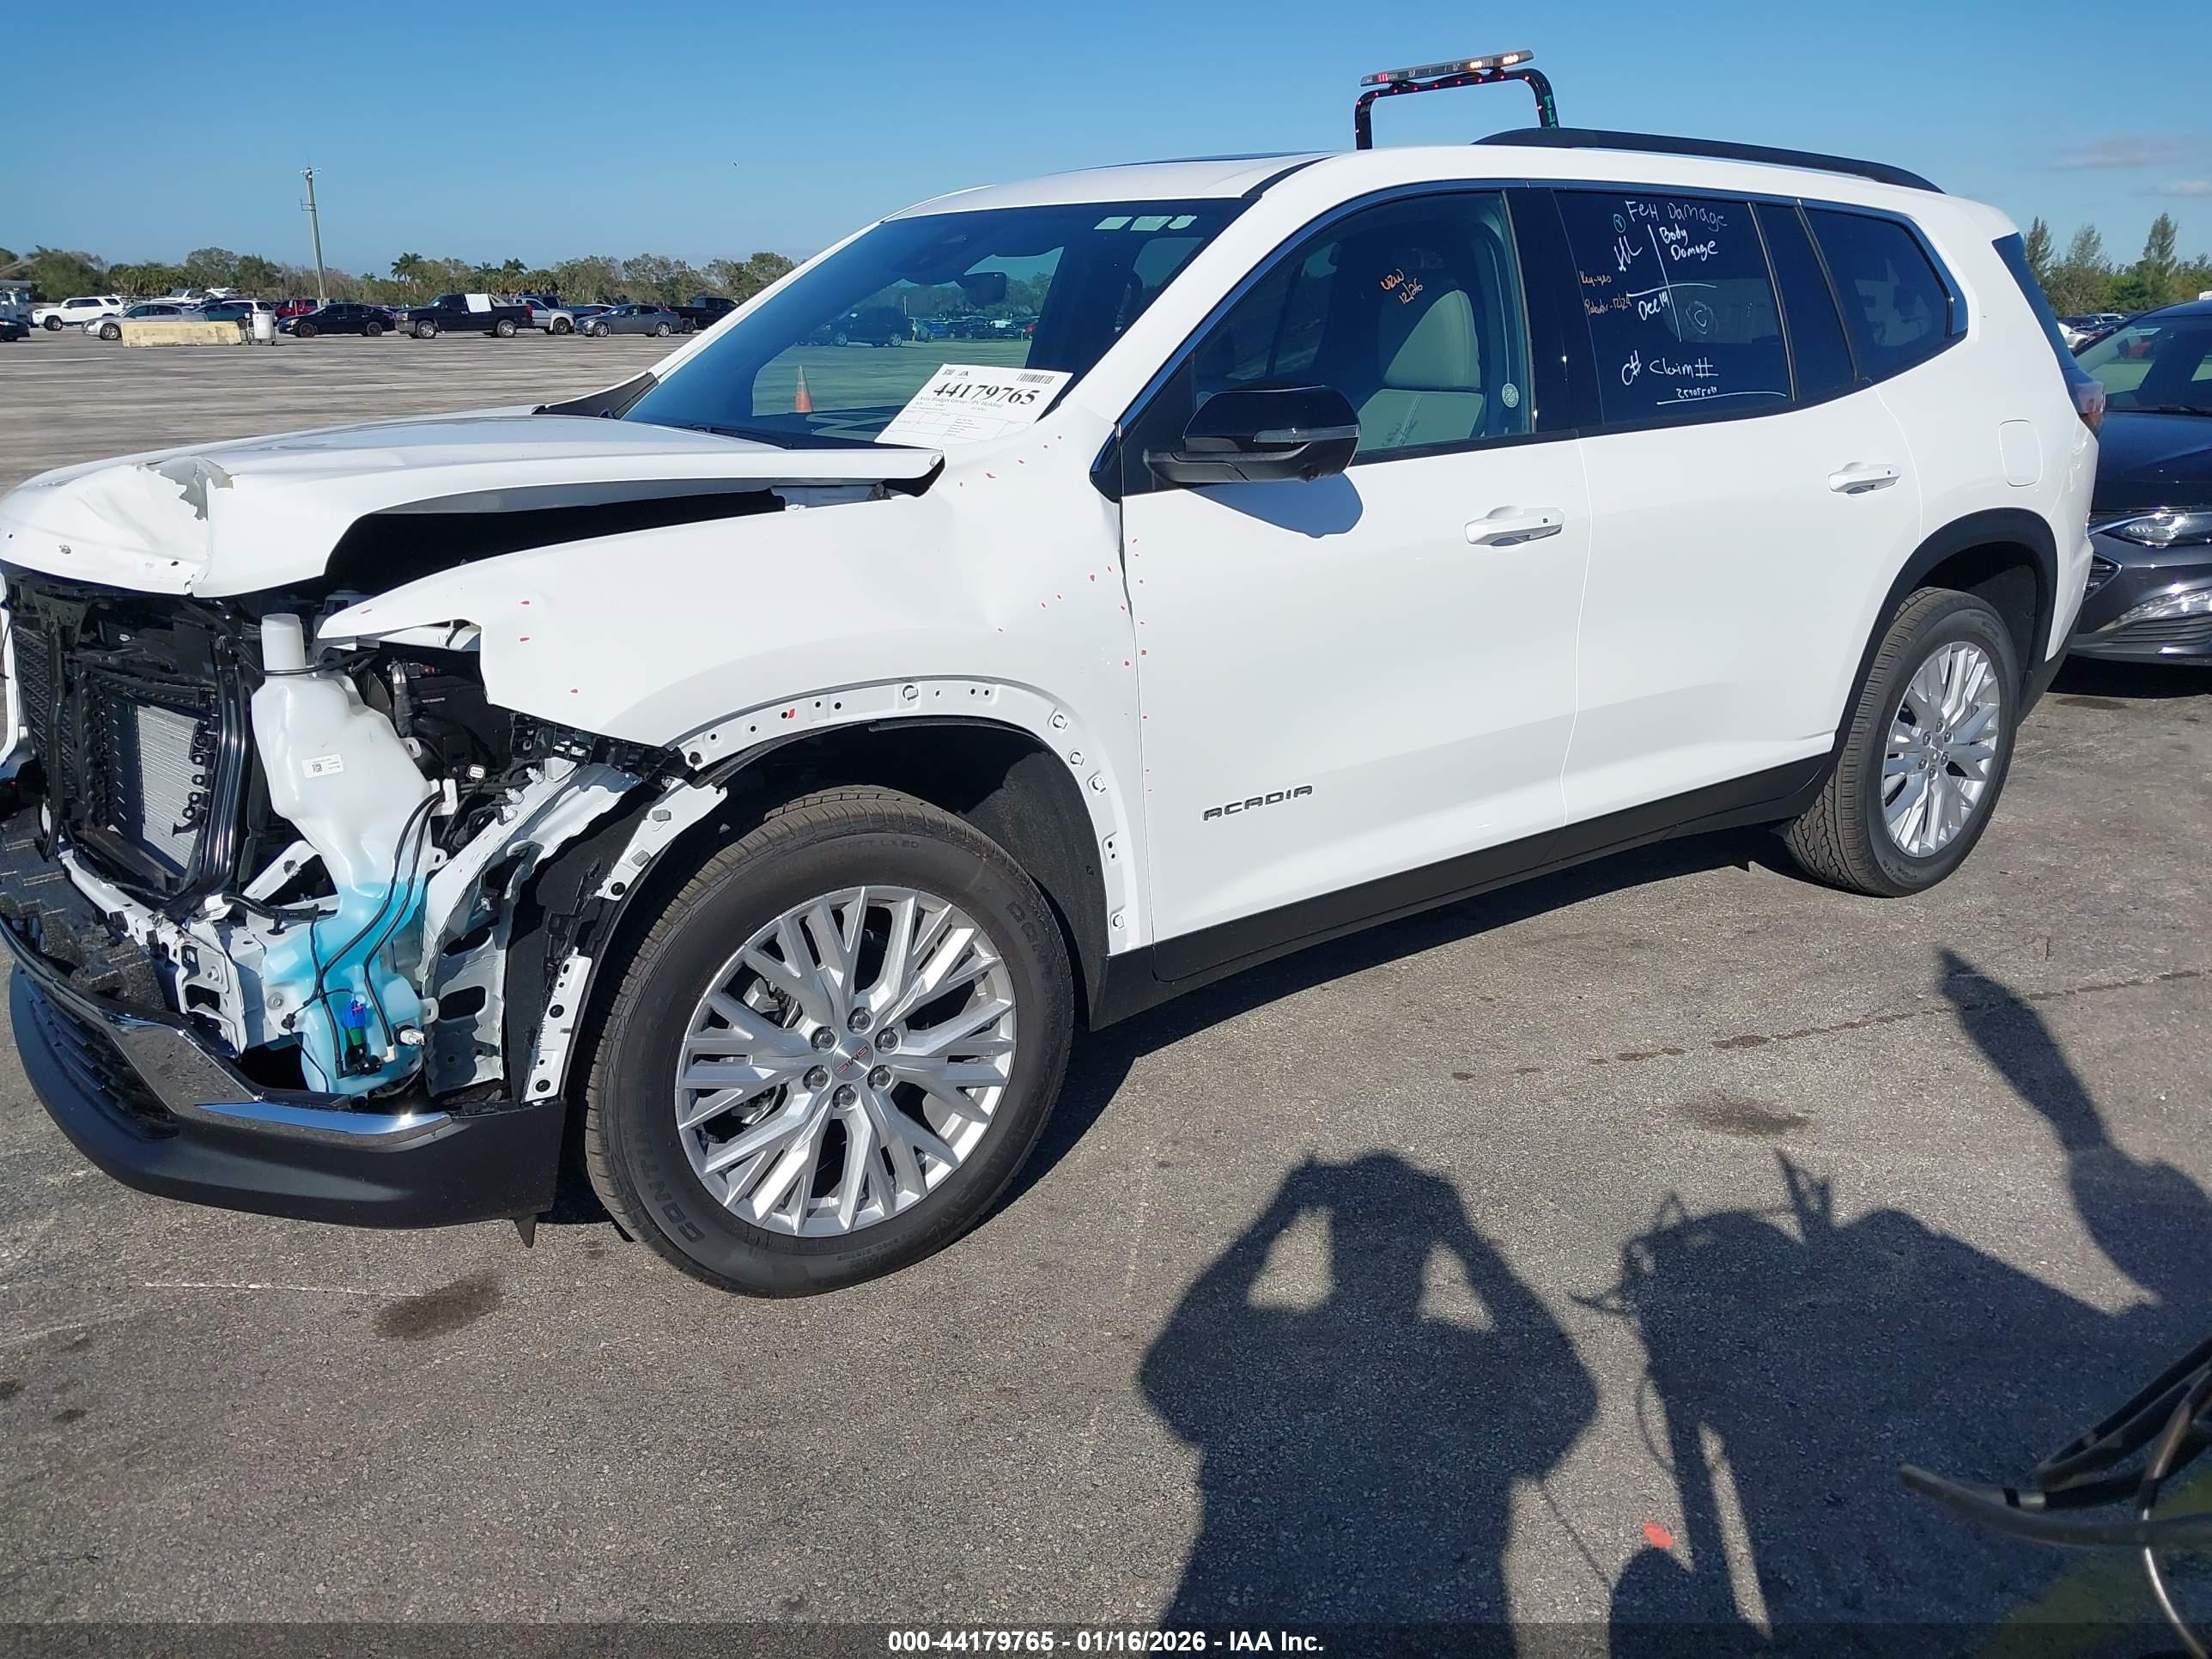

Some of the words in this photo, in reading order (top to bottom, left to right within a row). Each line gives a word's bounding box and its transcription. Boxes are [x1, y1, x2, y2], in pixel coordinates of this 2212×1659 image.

[1667, 202, 1728, 232] Damage
[1658, 222, 1688, 246] Body
[1670, 240, 1719, 262] Damage
[933, 381, 1041, 404] 44179765
[1203, 785, 1313, 822] ACADIA
[836, 1044, 868, 1073] GMC
